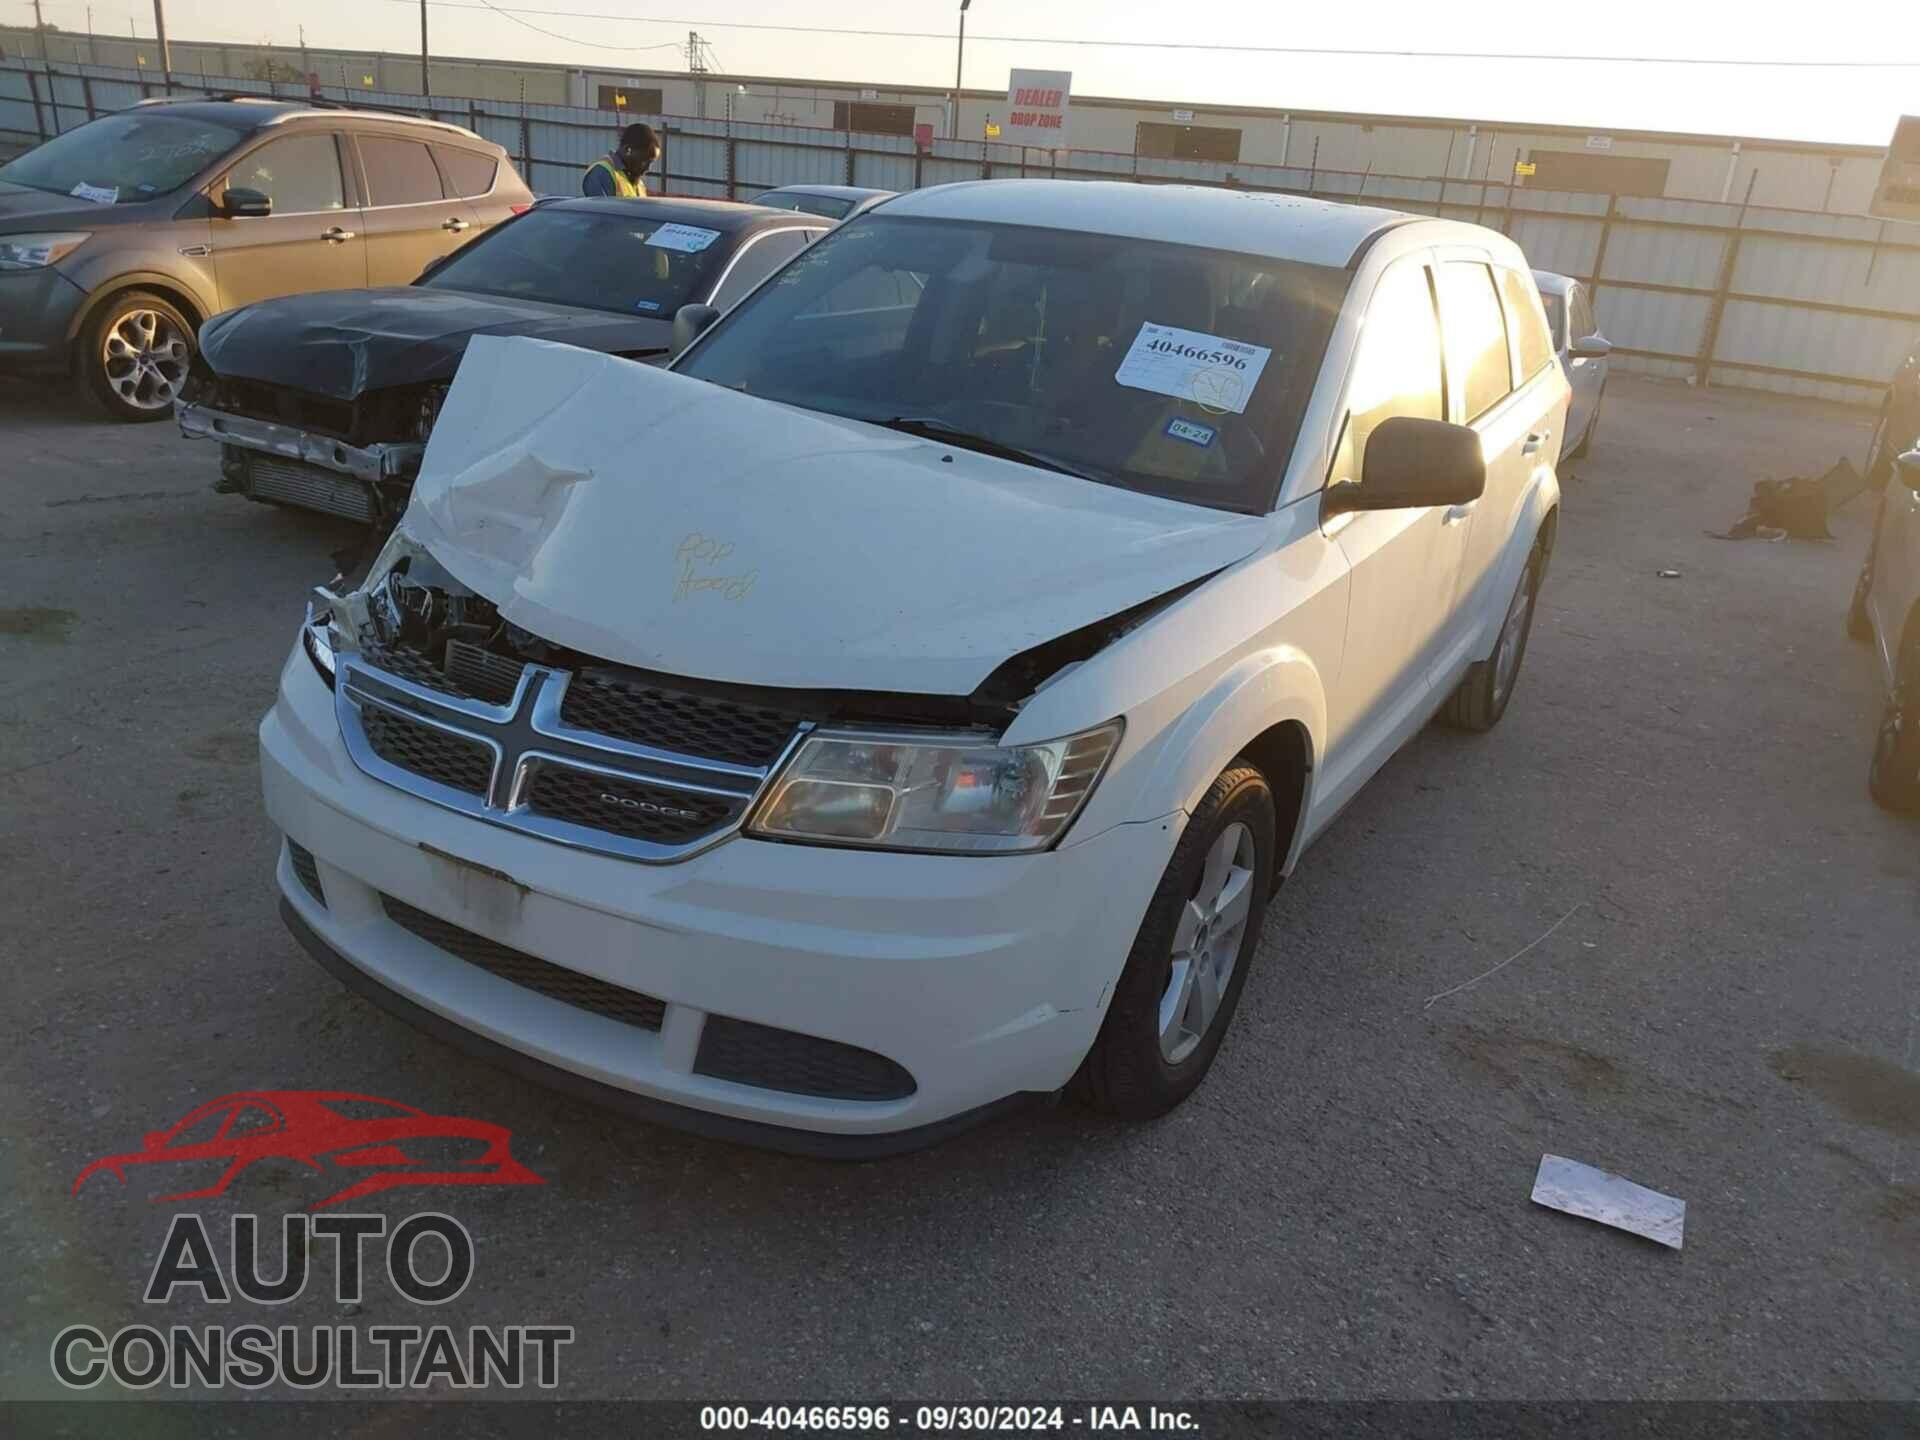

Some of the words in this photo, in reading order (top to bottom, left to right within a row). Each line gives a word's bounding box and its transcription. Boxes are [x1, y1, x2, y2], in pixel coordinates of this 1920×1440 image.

[1014, 87, 1061, 108] DEALER
[1010, 111, 1037, 127] DROP
[1038, 113, 1063, 129] ZONE
[1146, 338, 1248, 371] 40466596
[600, 793, 699, 820] DODGE
